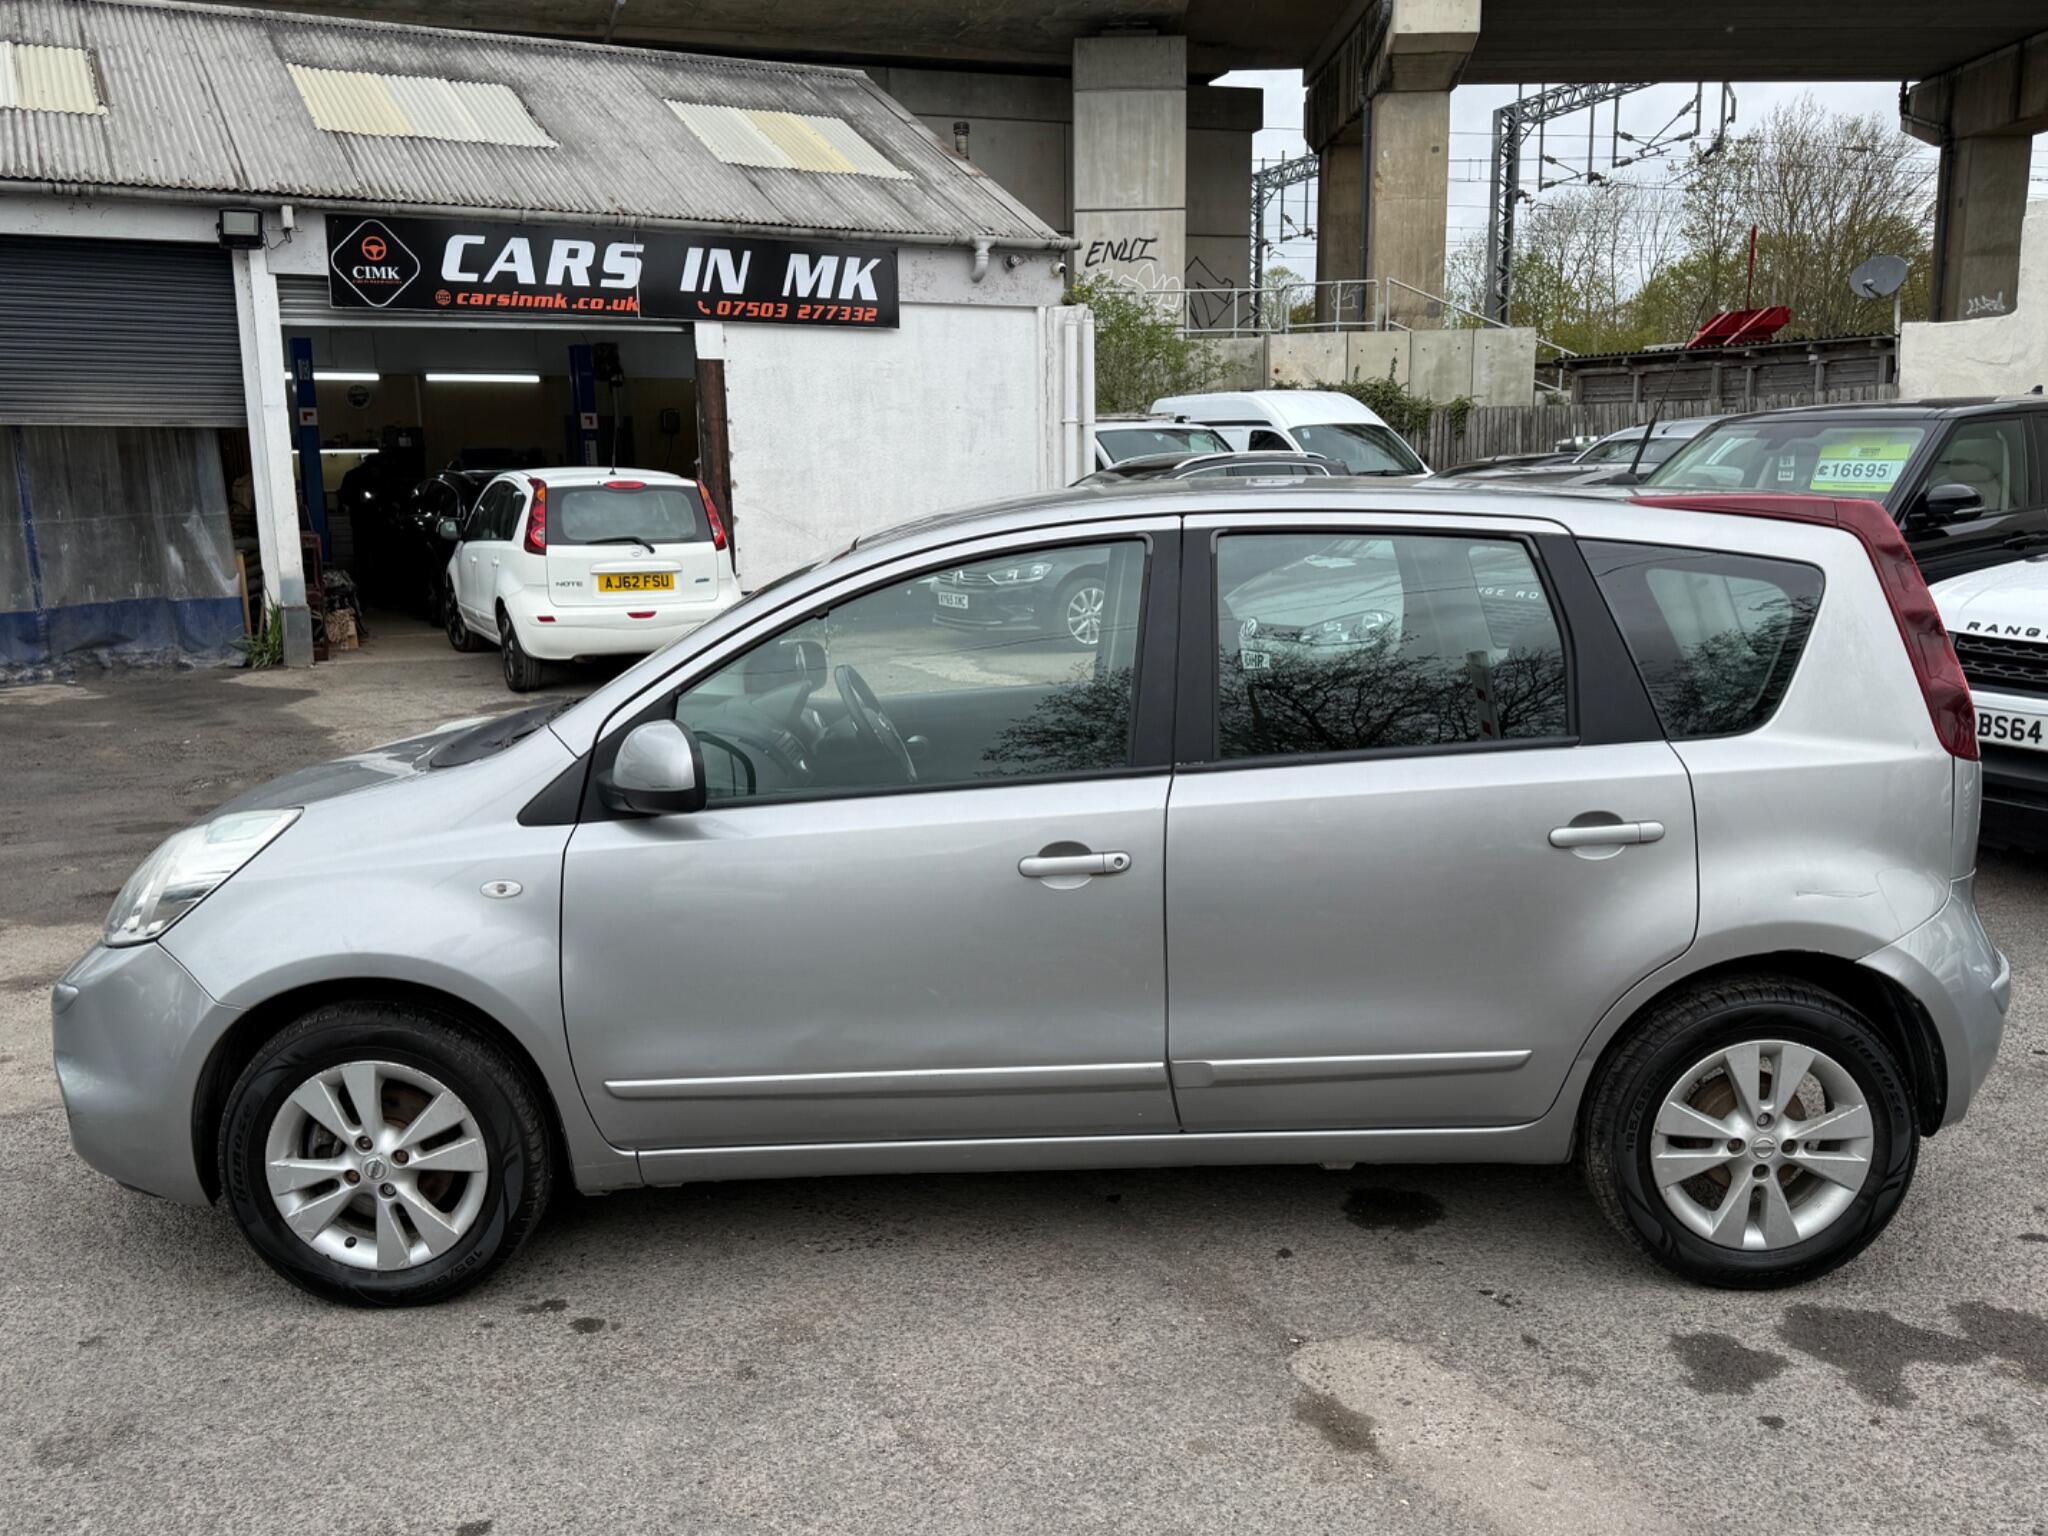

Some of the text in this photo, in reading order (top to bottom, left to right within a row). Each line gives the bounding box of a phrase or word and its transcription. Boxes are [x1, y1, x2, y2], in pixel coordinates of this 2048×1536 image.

[352, 265, 401, 280] CIMK
[441, 234, 881, 301] CARS IN MK
[456, 289, 639, 313] carsinmk.co.uk
[716, 301, 878, 322] 07503 277332
[605, 575, 669, 589] AJ62 FSU
[1966, 621, 2048, 639] RANG
[1977, 712, 2042, 744] BS64
